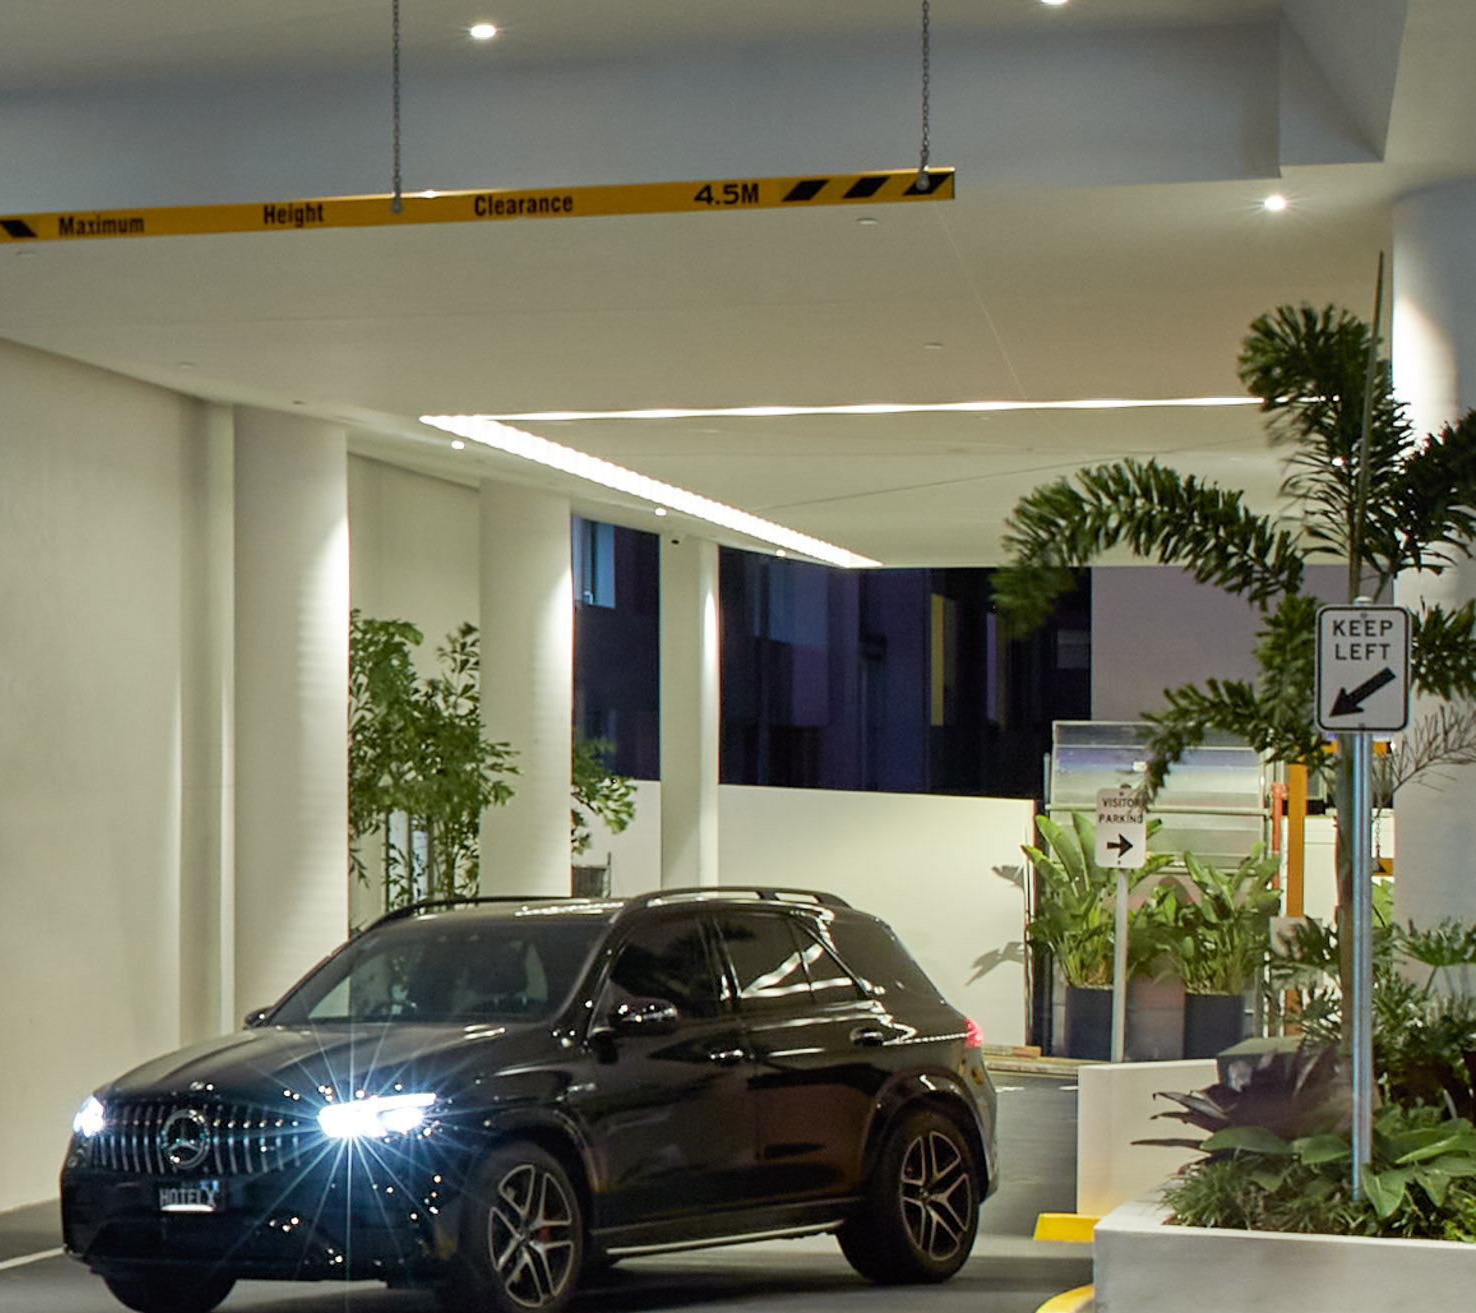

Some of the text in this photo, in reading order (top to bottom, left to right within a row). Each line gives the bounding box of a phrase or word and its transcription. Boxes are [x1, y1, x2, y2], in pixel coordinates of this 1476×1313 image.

[58, 183, 760, 236] Maximum Height Clearance 4.5M
[1332, 619, 1393, 637] KEEP
[1335, 643, 1391, 660] LEFT
[1098, 814, 1144, 824] PARKING
